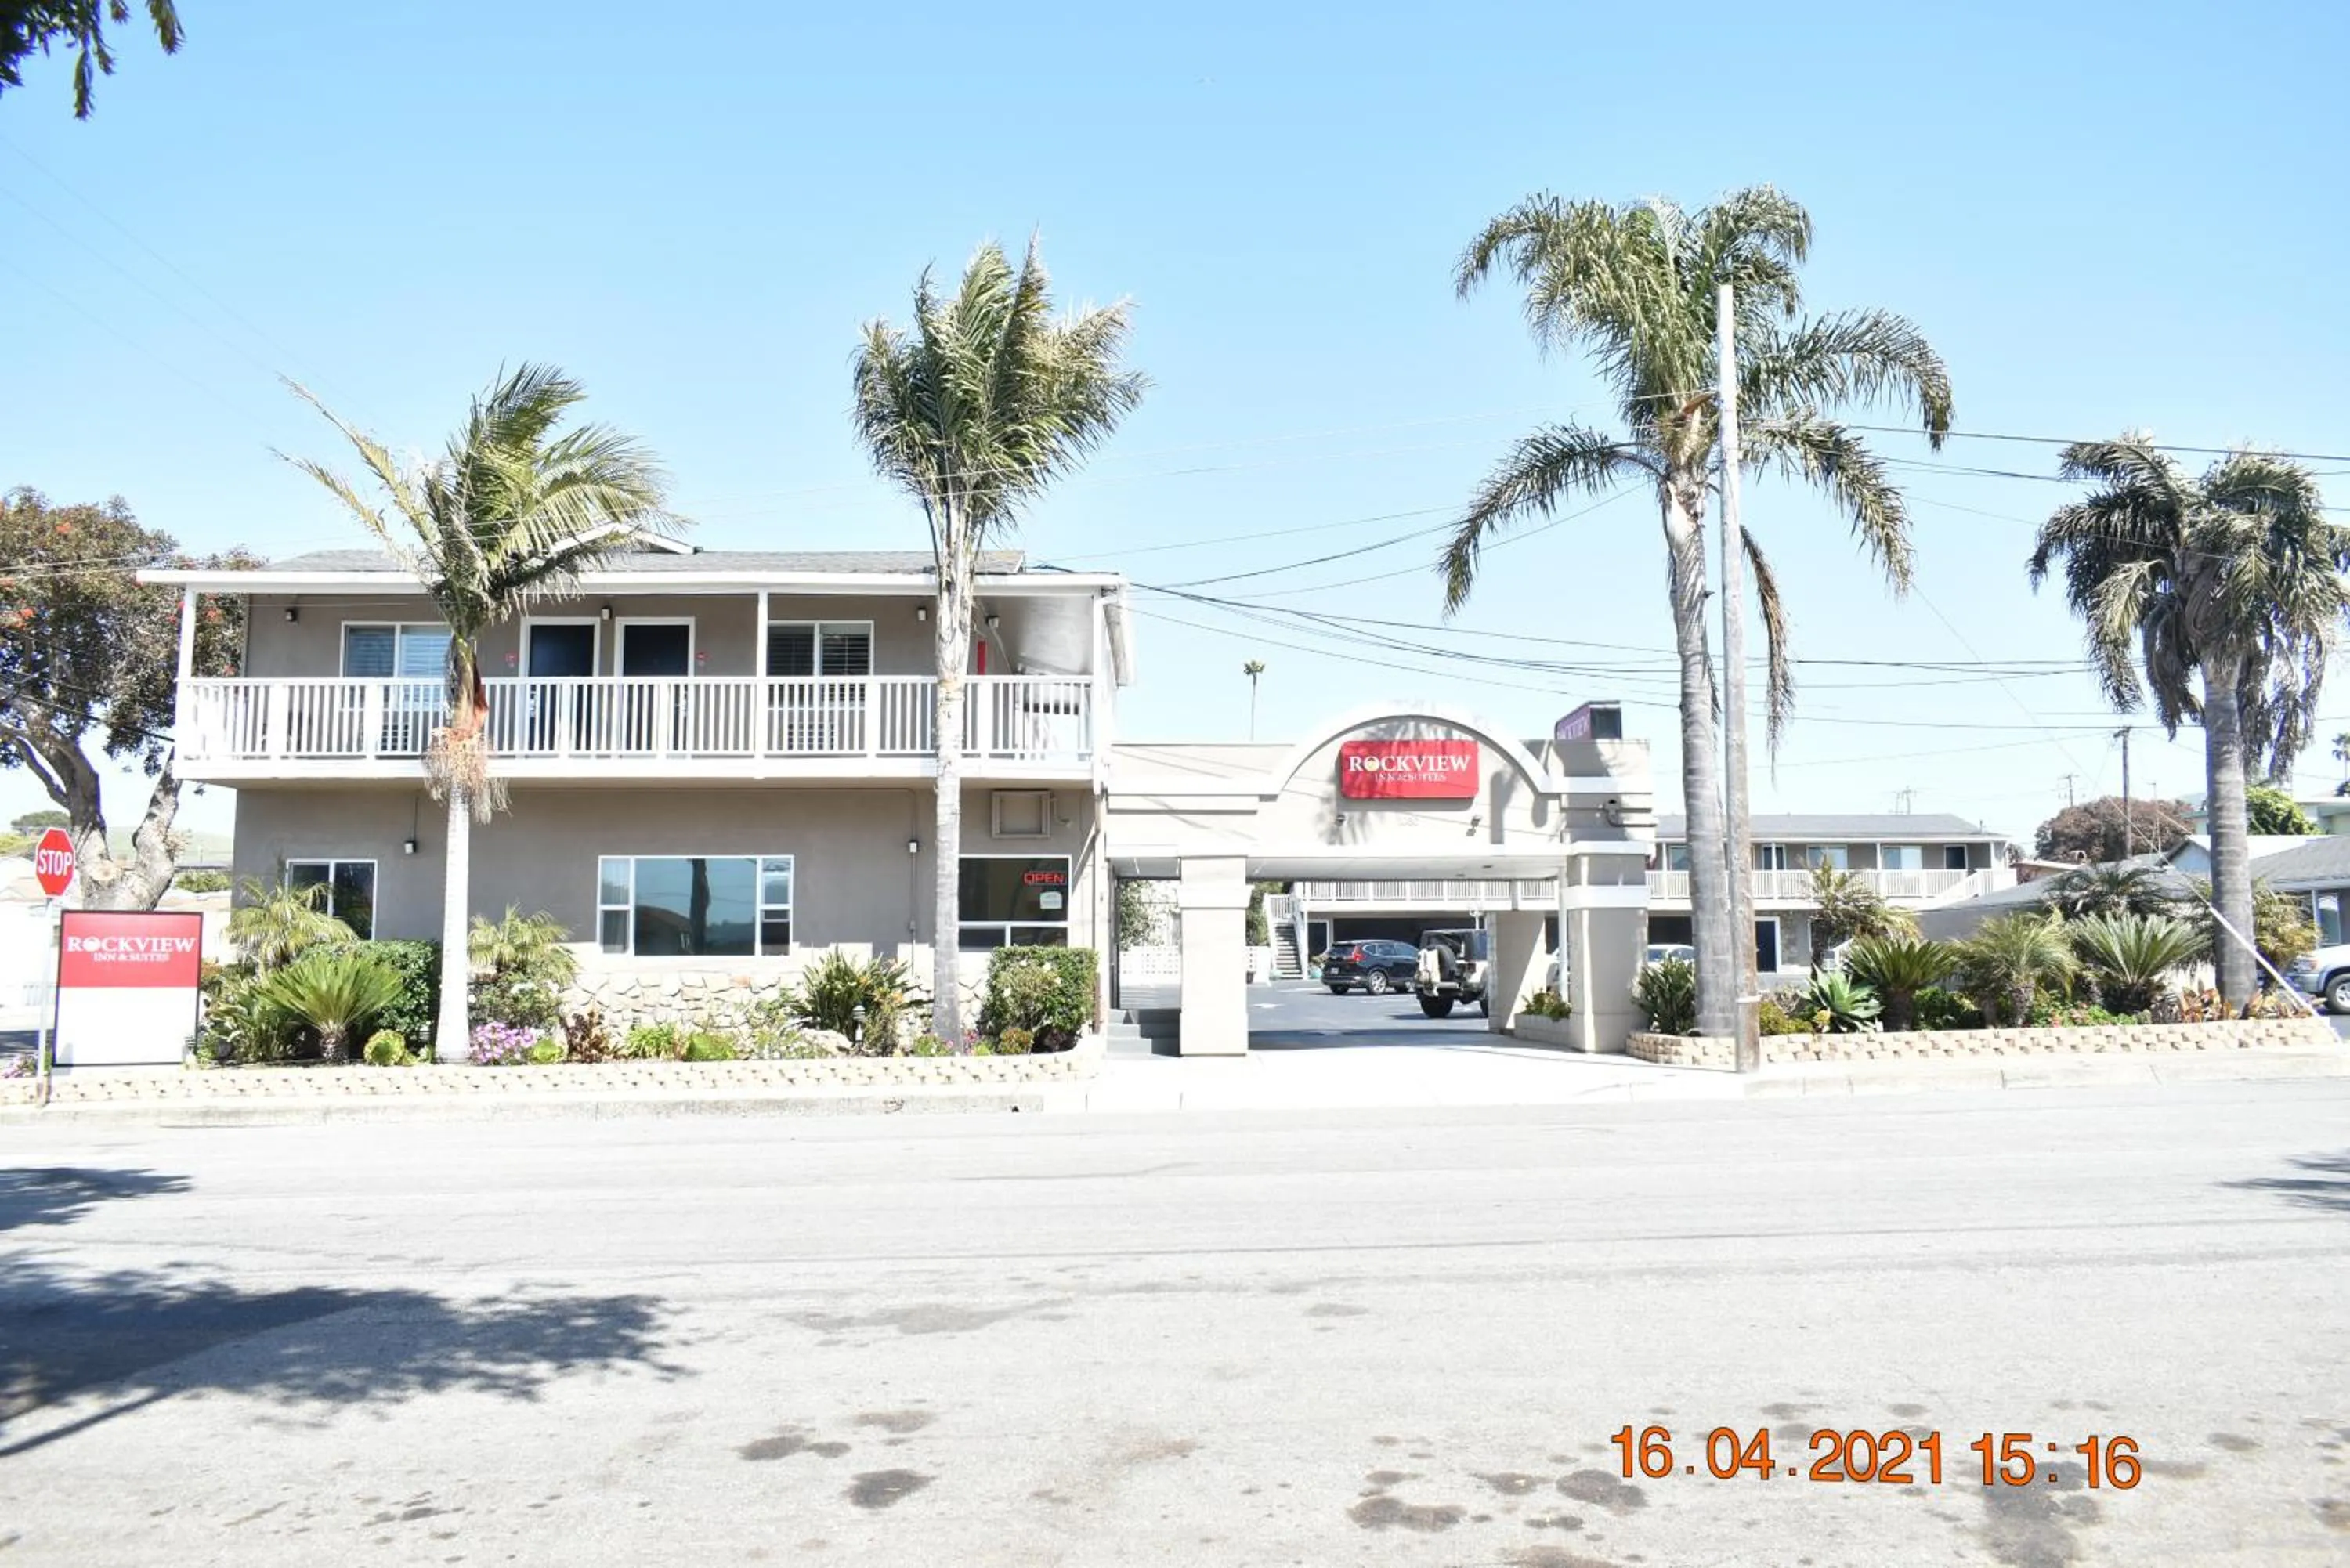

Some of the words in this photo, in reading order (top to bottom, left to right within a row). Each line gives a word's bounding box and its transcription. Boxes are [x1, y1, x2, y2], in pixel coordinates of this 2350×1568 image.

[1349, 755, 1471, 771] ROCKVIEW
[38, 848, 72, 876] STOP
[1024, 873, 1065, 884] OPEN
[67, 936, 196, 952] ROCKVIEW
[93, 952, 116, 963] INN
[128, 952, 171, 963] SUITES
